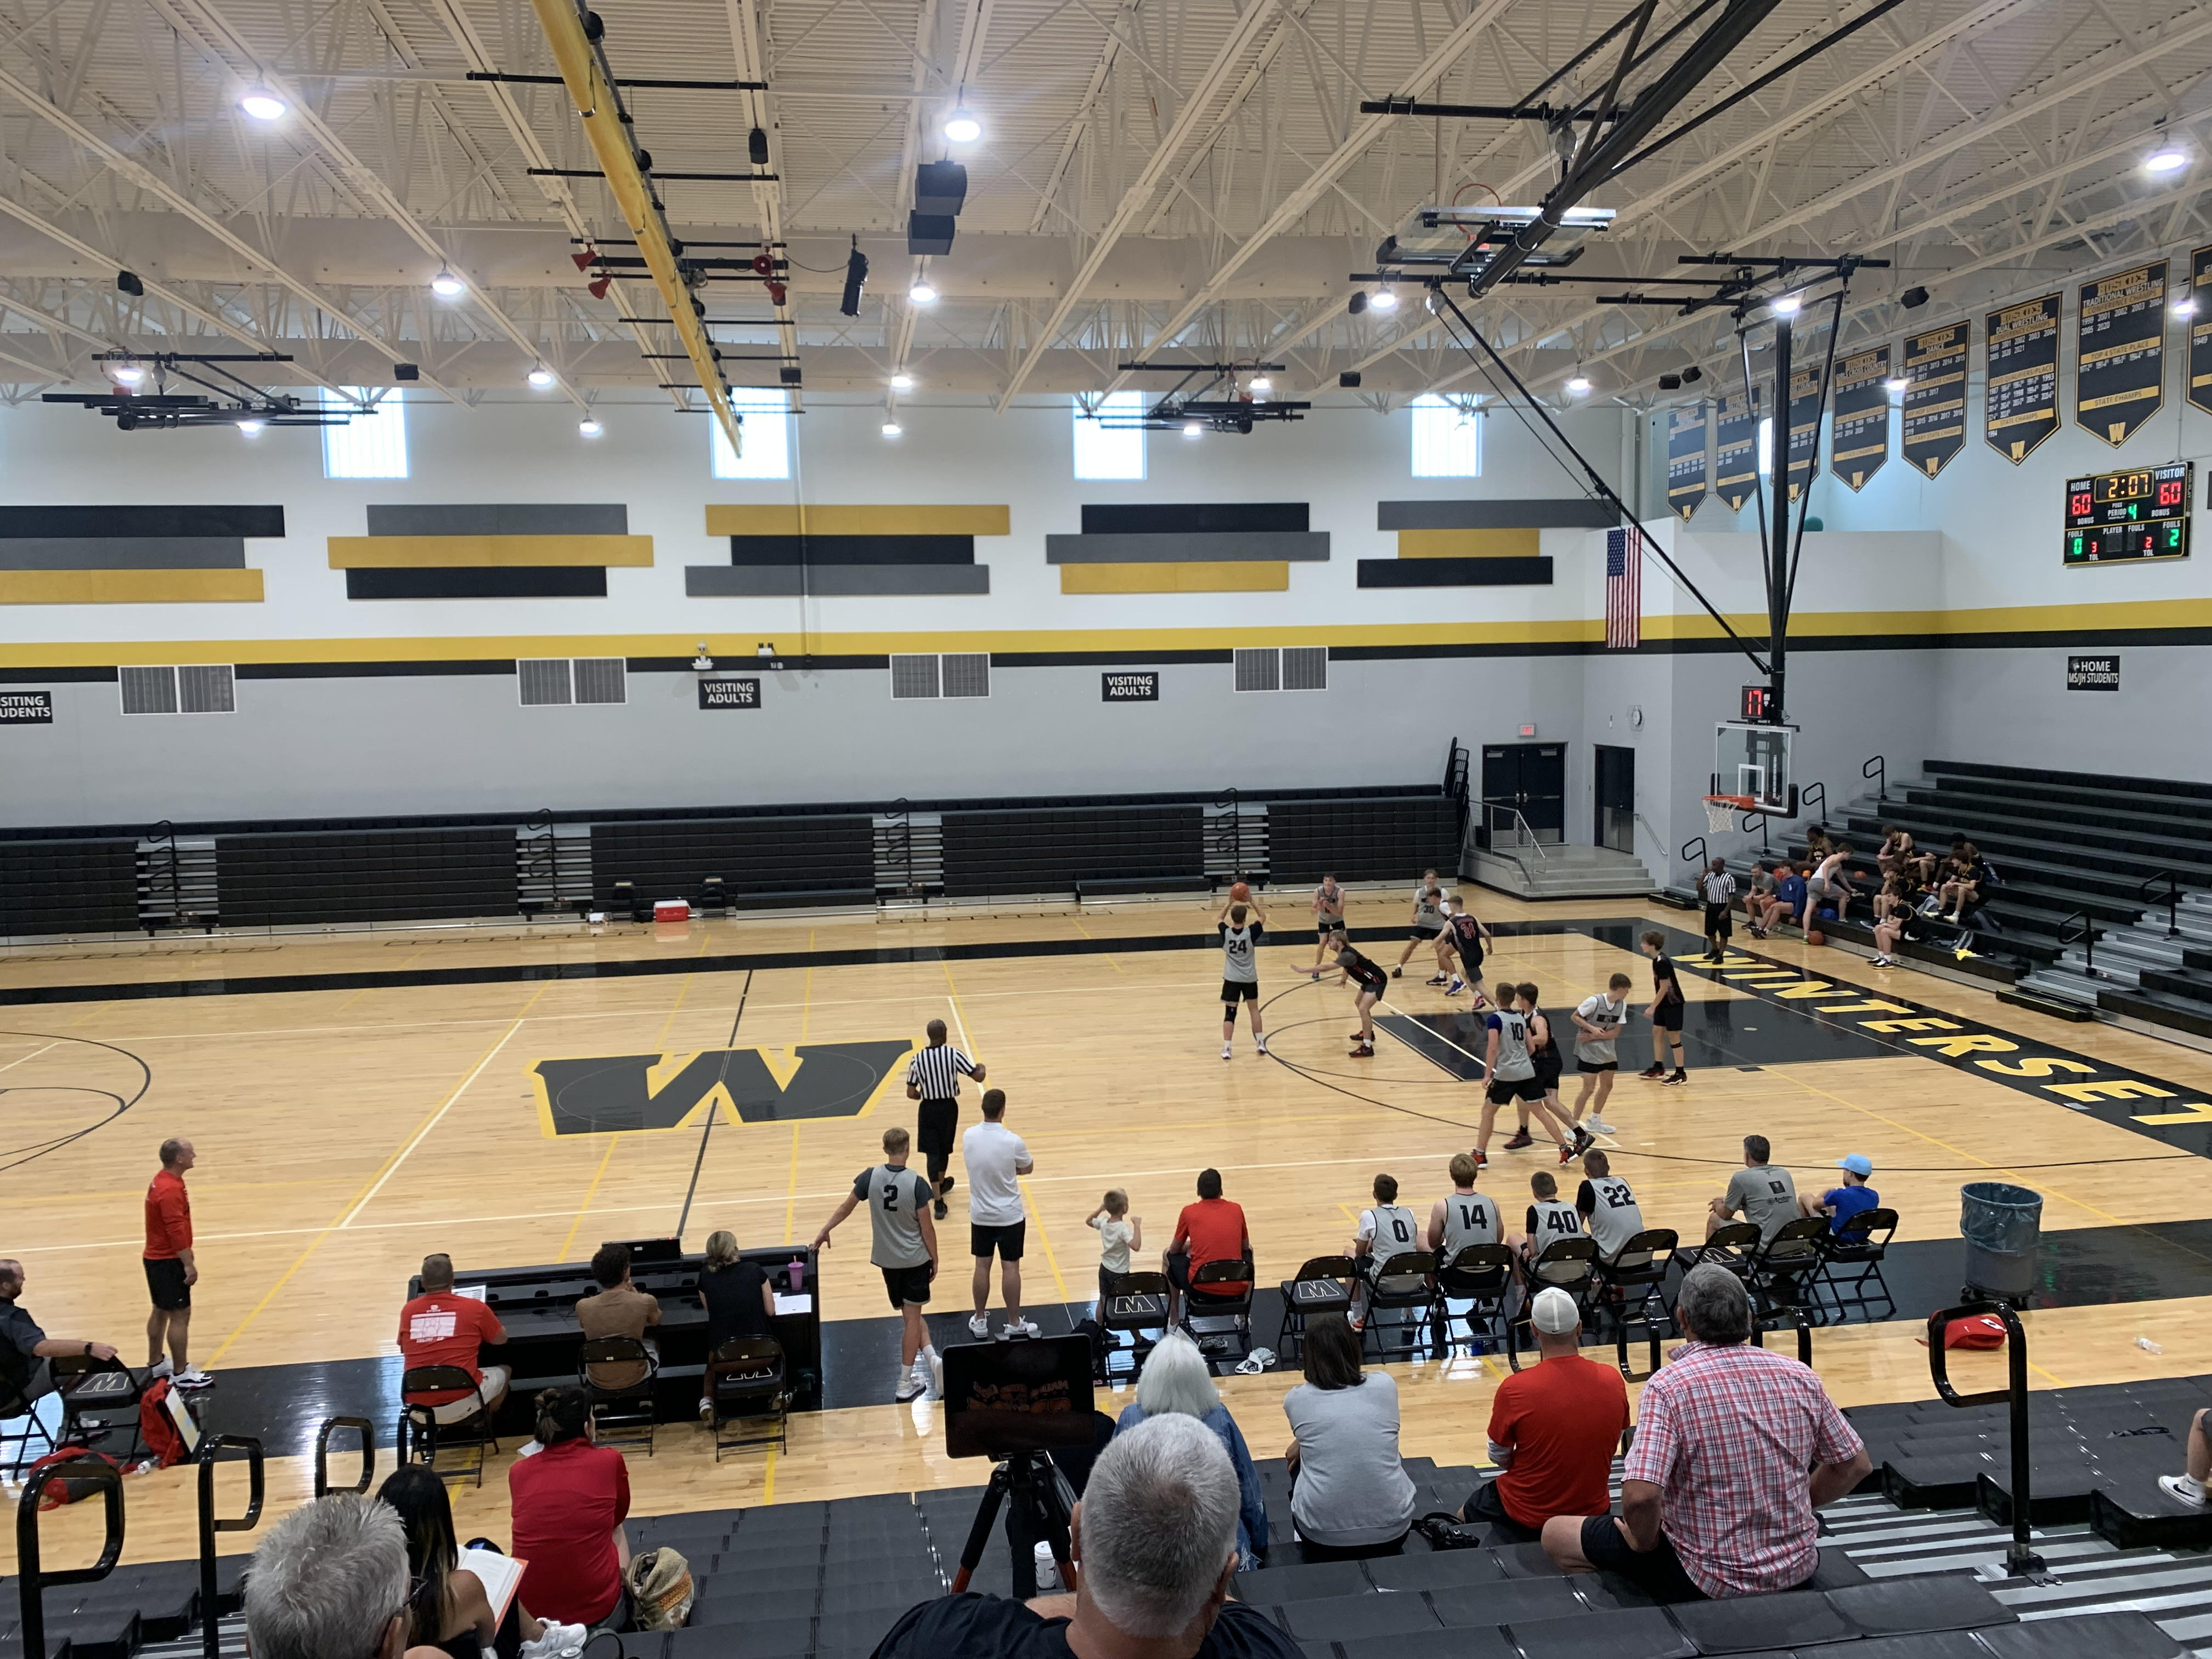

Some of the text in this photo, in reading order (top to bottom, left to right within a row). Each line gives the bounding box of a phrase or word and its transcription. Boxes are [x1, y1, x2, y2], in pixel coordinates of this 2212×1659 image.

[2097, 269, 2148, 296] HUSKIES
[2083, 278, 2164, 308] TRADITIONAL WRESTLING
[2088, 290, 2157, 314] CONFERENCE CHAMPS
[2114, 307, 2128, 317] 2002
[2132, 302, 2145, 312] 2003
[2149, 297, 2163, 307] 2004
[2001, 302, 2043, 325] HUSKIES
[1996, 312, 2048, 334] DUAL WRESTLING
[2027, 320, 2050, 332] CHAMPS
[2028, 331, 2040, 341] 2003
[1927, 342, 1944, 354] DANCE
[2130, 340, 2149, 350] PLACE
[1865, 360, 1887, 372] COUNTRY
[1918, 364, 1927, 373] 2012
[1930, 361, 1940, 369] 2013
[1942, 358, 1953, 366] 2014
[1955, 354, 1965, 363] 2015
[2042, 373, 2055, 382] 1993
[2095, 391, 2142, 406] STATE CHAMPS
[1941, 411, 1950, 420] 2017
[2000, 413, 2038, 426] STATE CHAMPS
[2108, 422, 2126, 442] W
[2011, 441, 2025, 459] W
[1926, 457, 1939, 474] W
[2071, 467, 2185, 498] HOME 2:07 VISITOR
[2072, 482, 2181, 515] 60 60
[2108, 504, 2137, 520] PERIOD 4
[2152, 509, 2170, 517] BONUS
[2078, 517, 2094, 525] BONUS
[2163, 521, 2181, 529] FOULS
[2068, 530, 2083, 538] FOULS
[2103, 524, 2145, 534] PLAYER FOULS
[2073, 529, 2179, 555] 0 3 2 2
[2081, 661, 2111, 672] HOME
[1107, 676, 1153, 686] VISITING
[2087, 673, 2118, 684] STUDENTS
[704, 682, 754, 693] VISITING
[1110, 686, 1151, 696] ADULTS
[1, 696, 44, 707] SITING
[708, 693, 753, 703] ADULTS
[1748, 690, 1762, 716] 17
[0, 707, 50, 718] UDENTS
[1424, 905, 1435, 913] 30
[1229, 939, 1247, 954] 24
[1510, 1022, 1524, 1041] 10
[1671, 951, 2212, 1126] WINTERSET
[521, 1037, 924, 1139] W
[884, 1184, 898, 1211] 2
[1603, 1184, 1636, 1208] 22
[1460, 1204, 1487, 1229] 14
[1547, 1210, 1577, 1234] 40
[1392, 1220, 1409, 1243] 0
